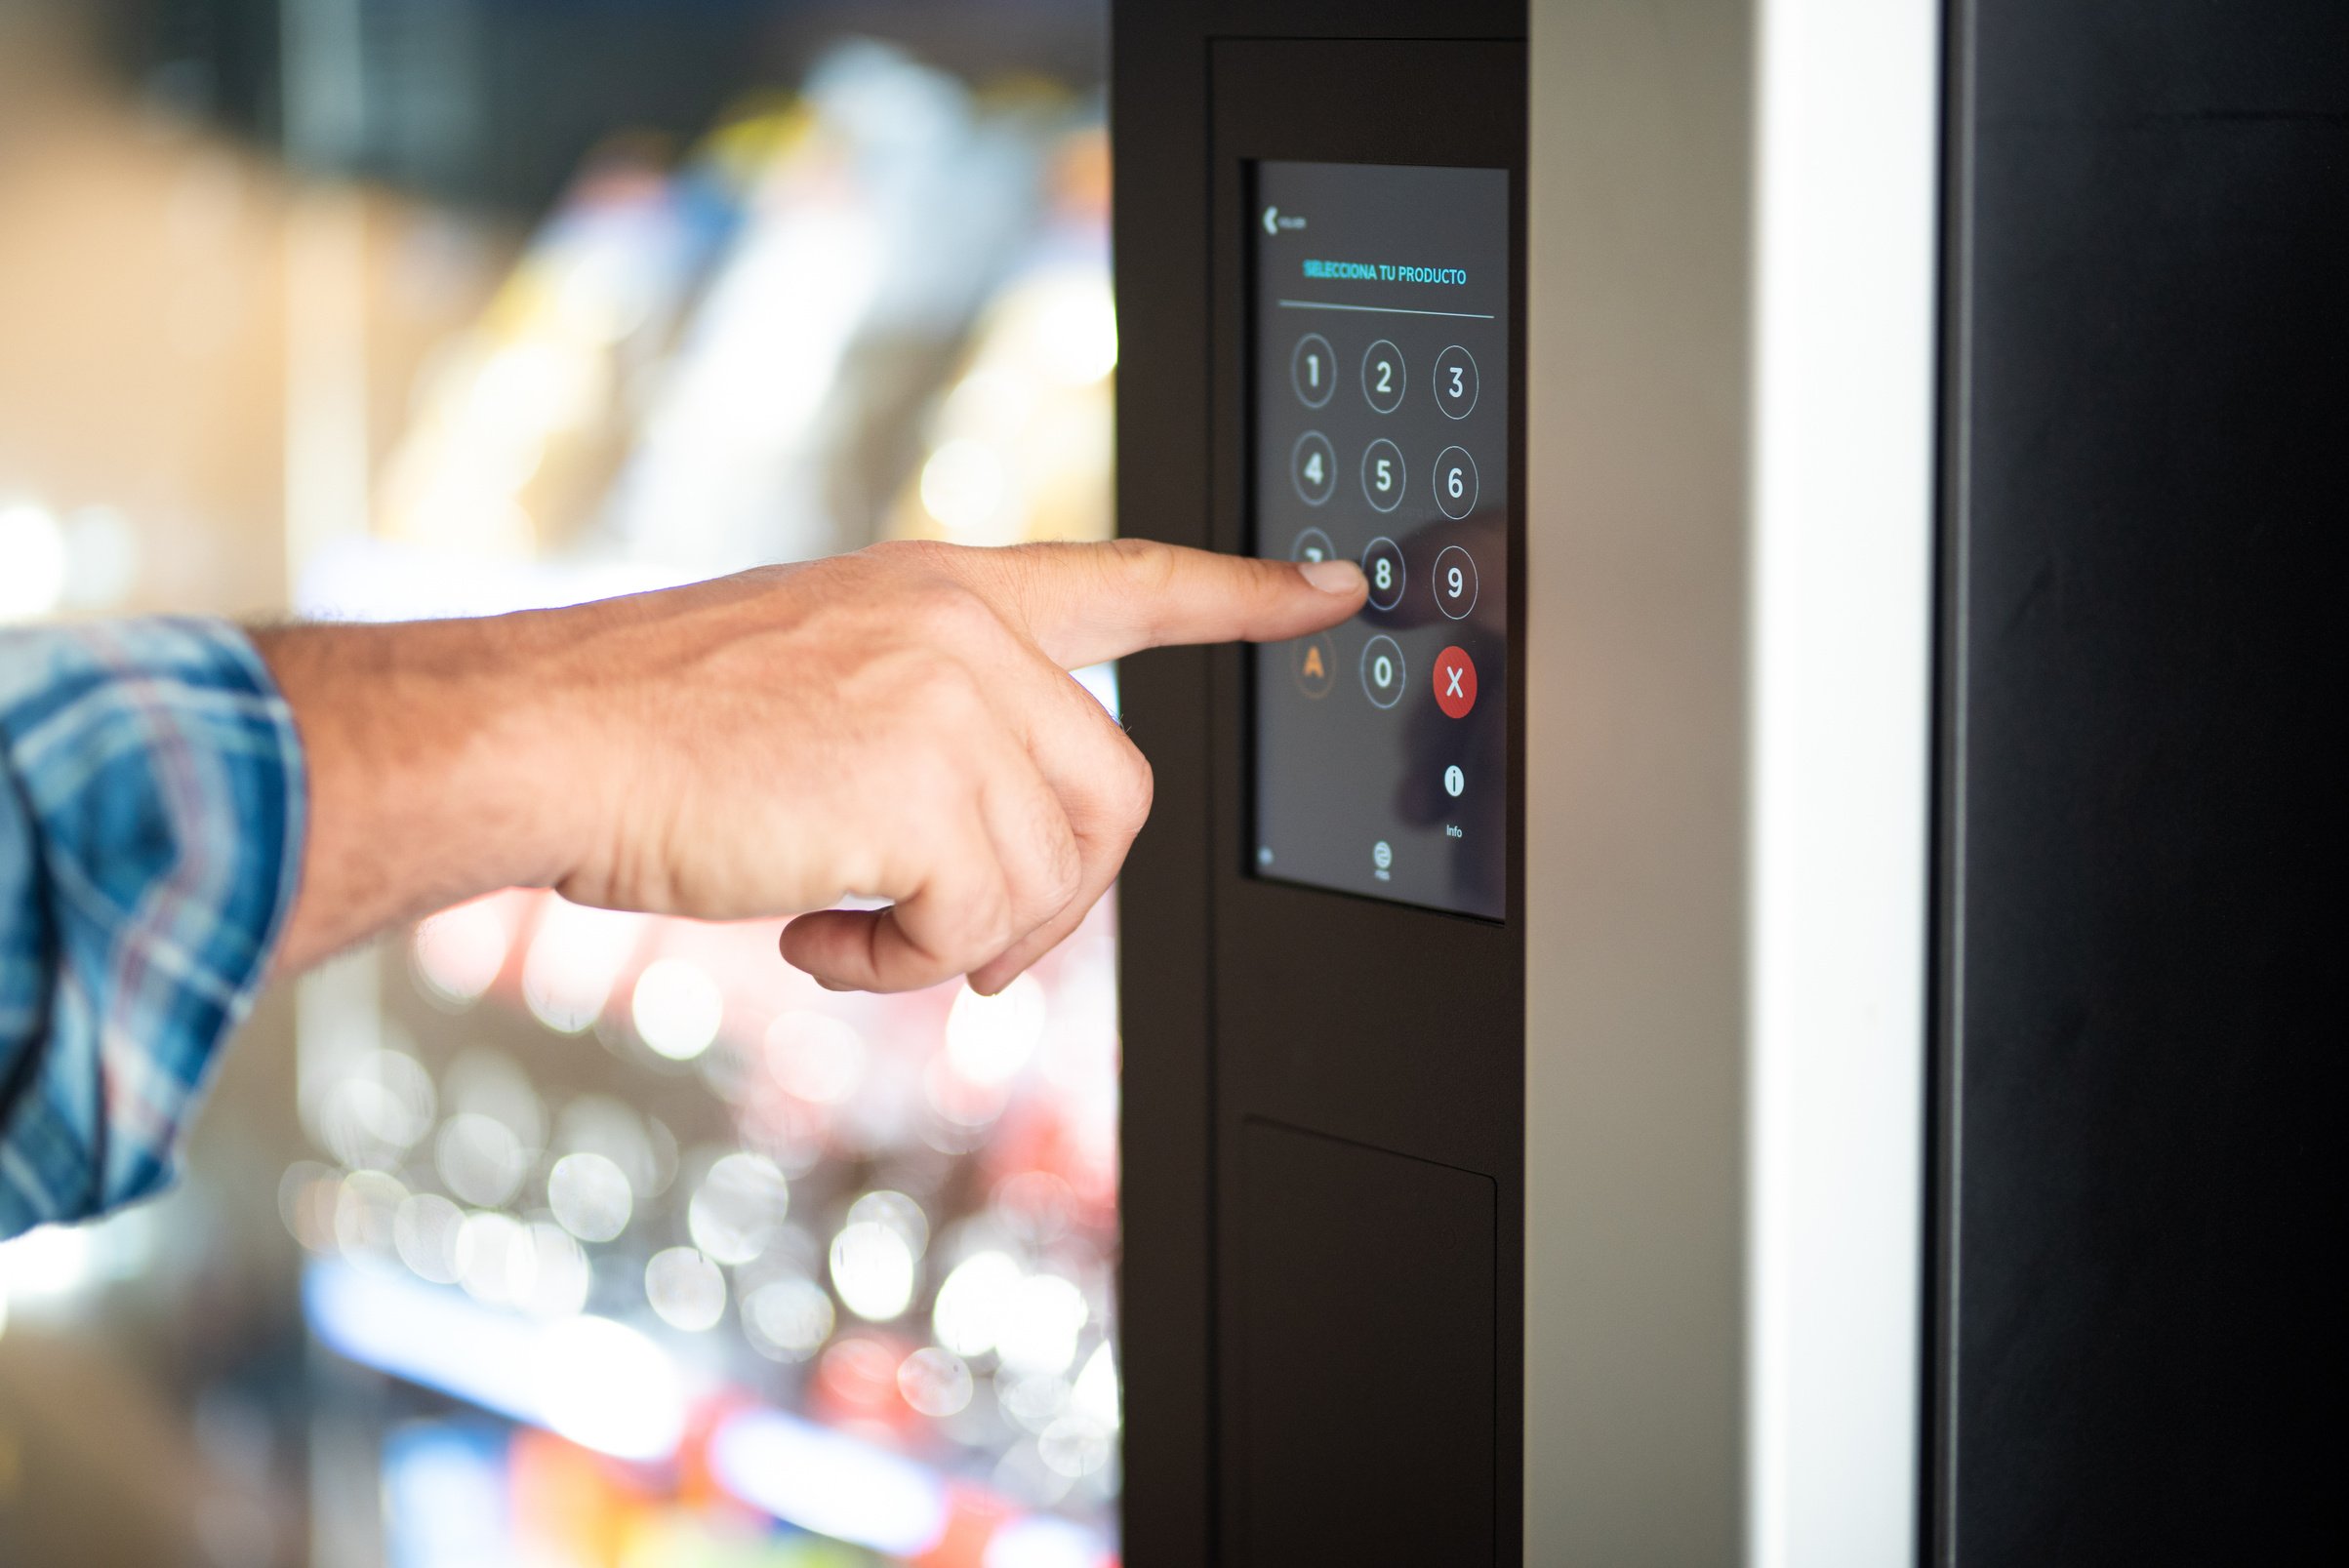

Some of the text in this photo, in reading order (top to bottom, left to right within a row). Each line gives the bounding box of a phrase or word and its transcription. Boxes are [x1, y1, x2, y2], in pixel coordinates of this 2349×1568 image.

[1303, 259, 1467, 285] SELECCIONA TU PRODUCTO
[1307, 354, 1463, 398] 1 2 3
[1304, 452, 1464, 499] 4 5 6
[1376, 558, 1392, 590] 8
[1447, 567, 1463, 598] 9
[1303, 646, 1463, 699] A 0 X
[1446, 824, 1463, 838] Info
